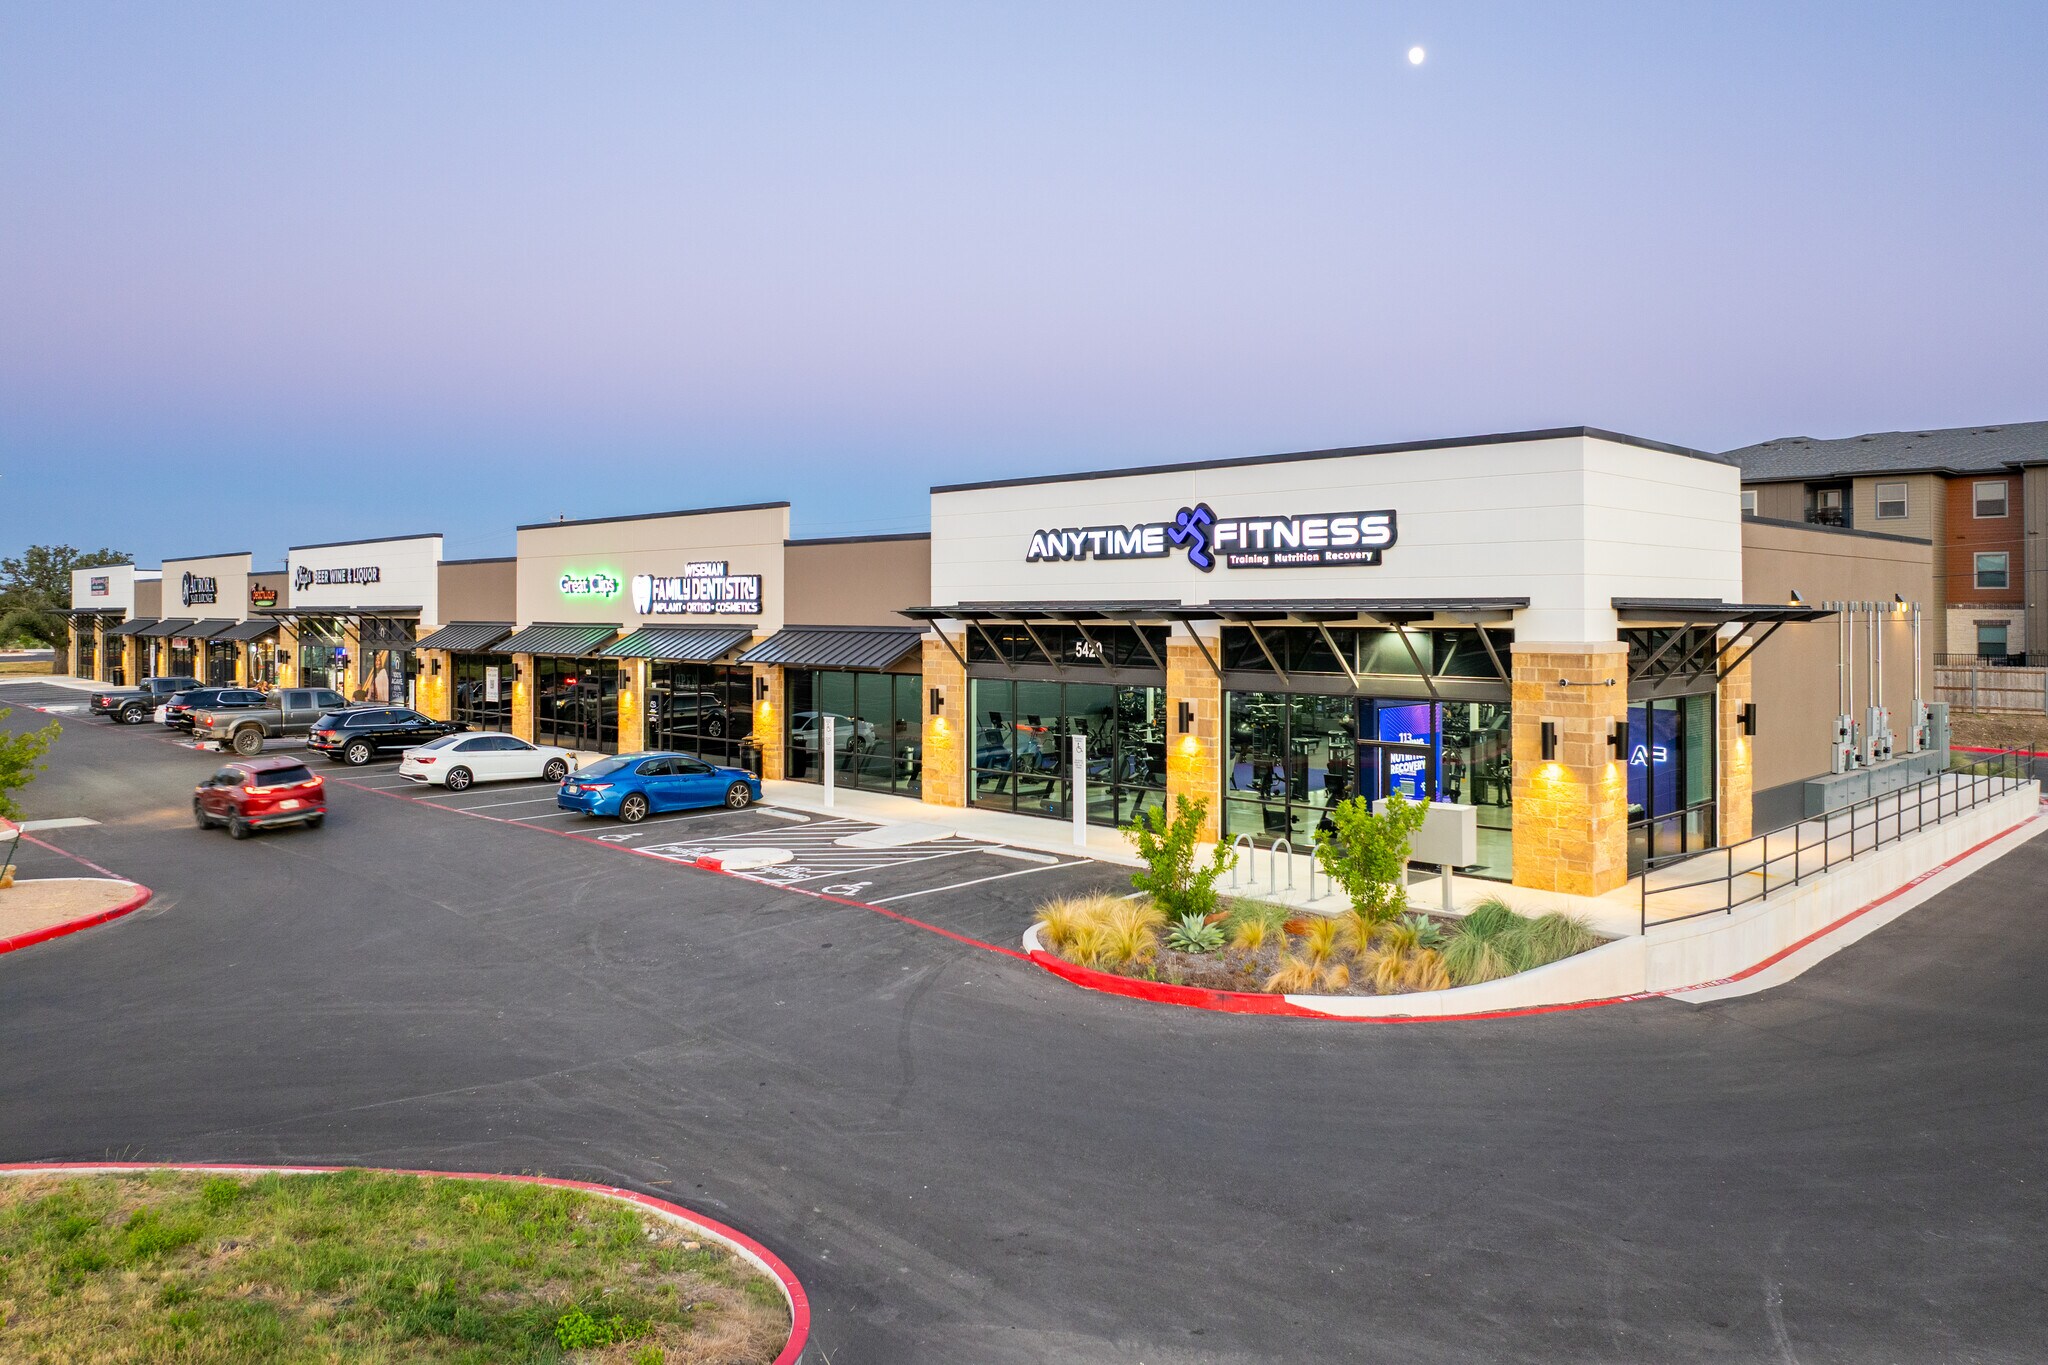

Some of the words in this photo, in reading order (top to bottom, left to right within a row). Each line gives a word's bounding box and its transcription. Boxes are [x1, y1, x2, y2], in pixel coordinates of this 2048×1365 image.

[1028, 528, 1164, 557] ANYTIME
[1213, 515, 1391, 550] FITNESS
[1230, 554, 1269, 565] Training
[1274, 552, 1320, 563] Nutrition
[1325, 551, 1373, 562] Recovery
[315, 569, 330, 584] BEER
[330, 568, 347, 583] WINE
[353, 567, 378, 585] LIQUOR
[685, 562, 724, 578] WISEMAN
[560, 574, 590, 594] Great
[591, 573, 618, 598] Clips
[652, 578, 691, 601] FAMILY
[691, 576, 758, 601] DENTISTRY
[652, 602, 683, 613] IMPLANT
[686, 602, 711, 612] ORTHO
[715, 601, 758, 613] COSMETICS
